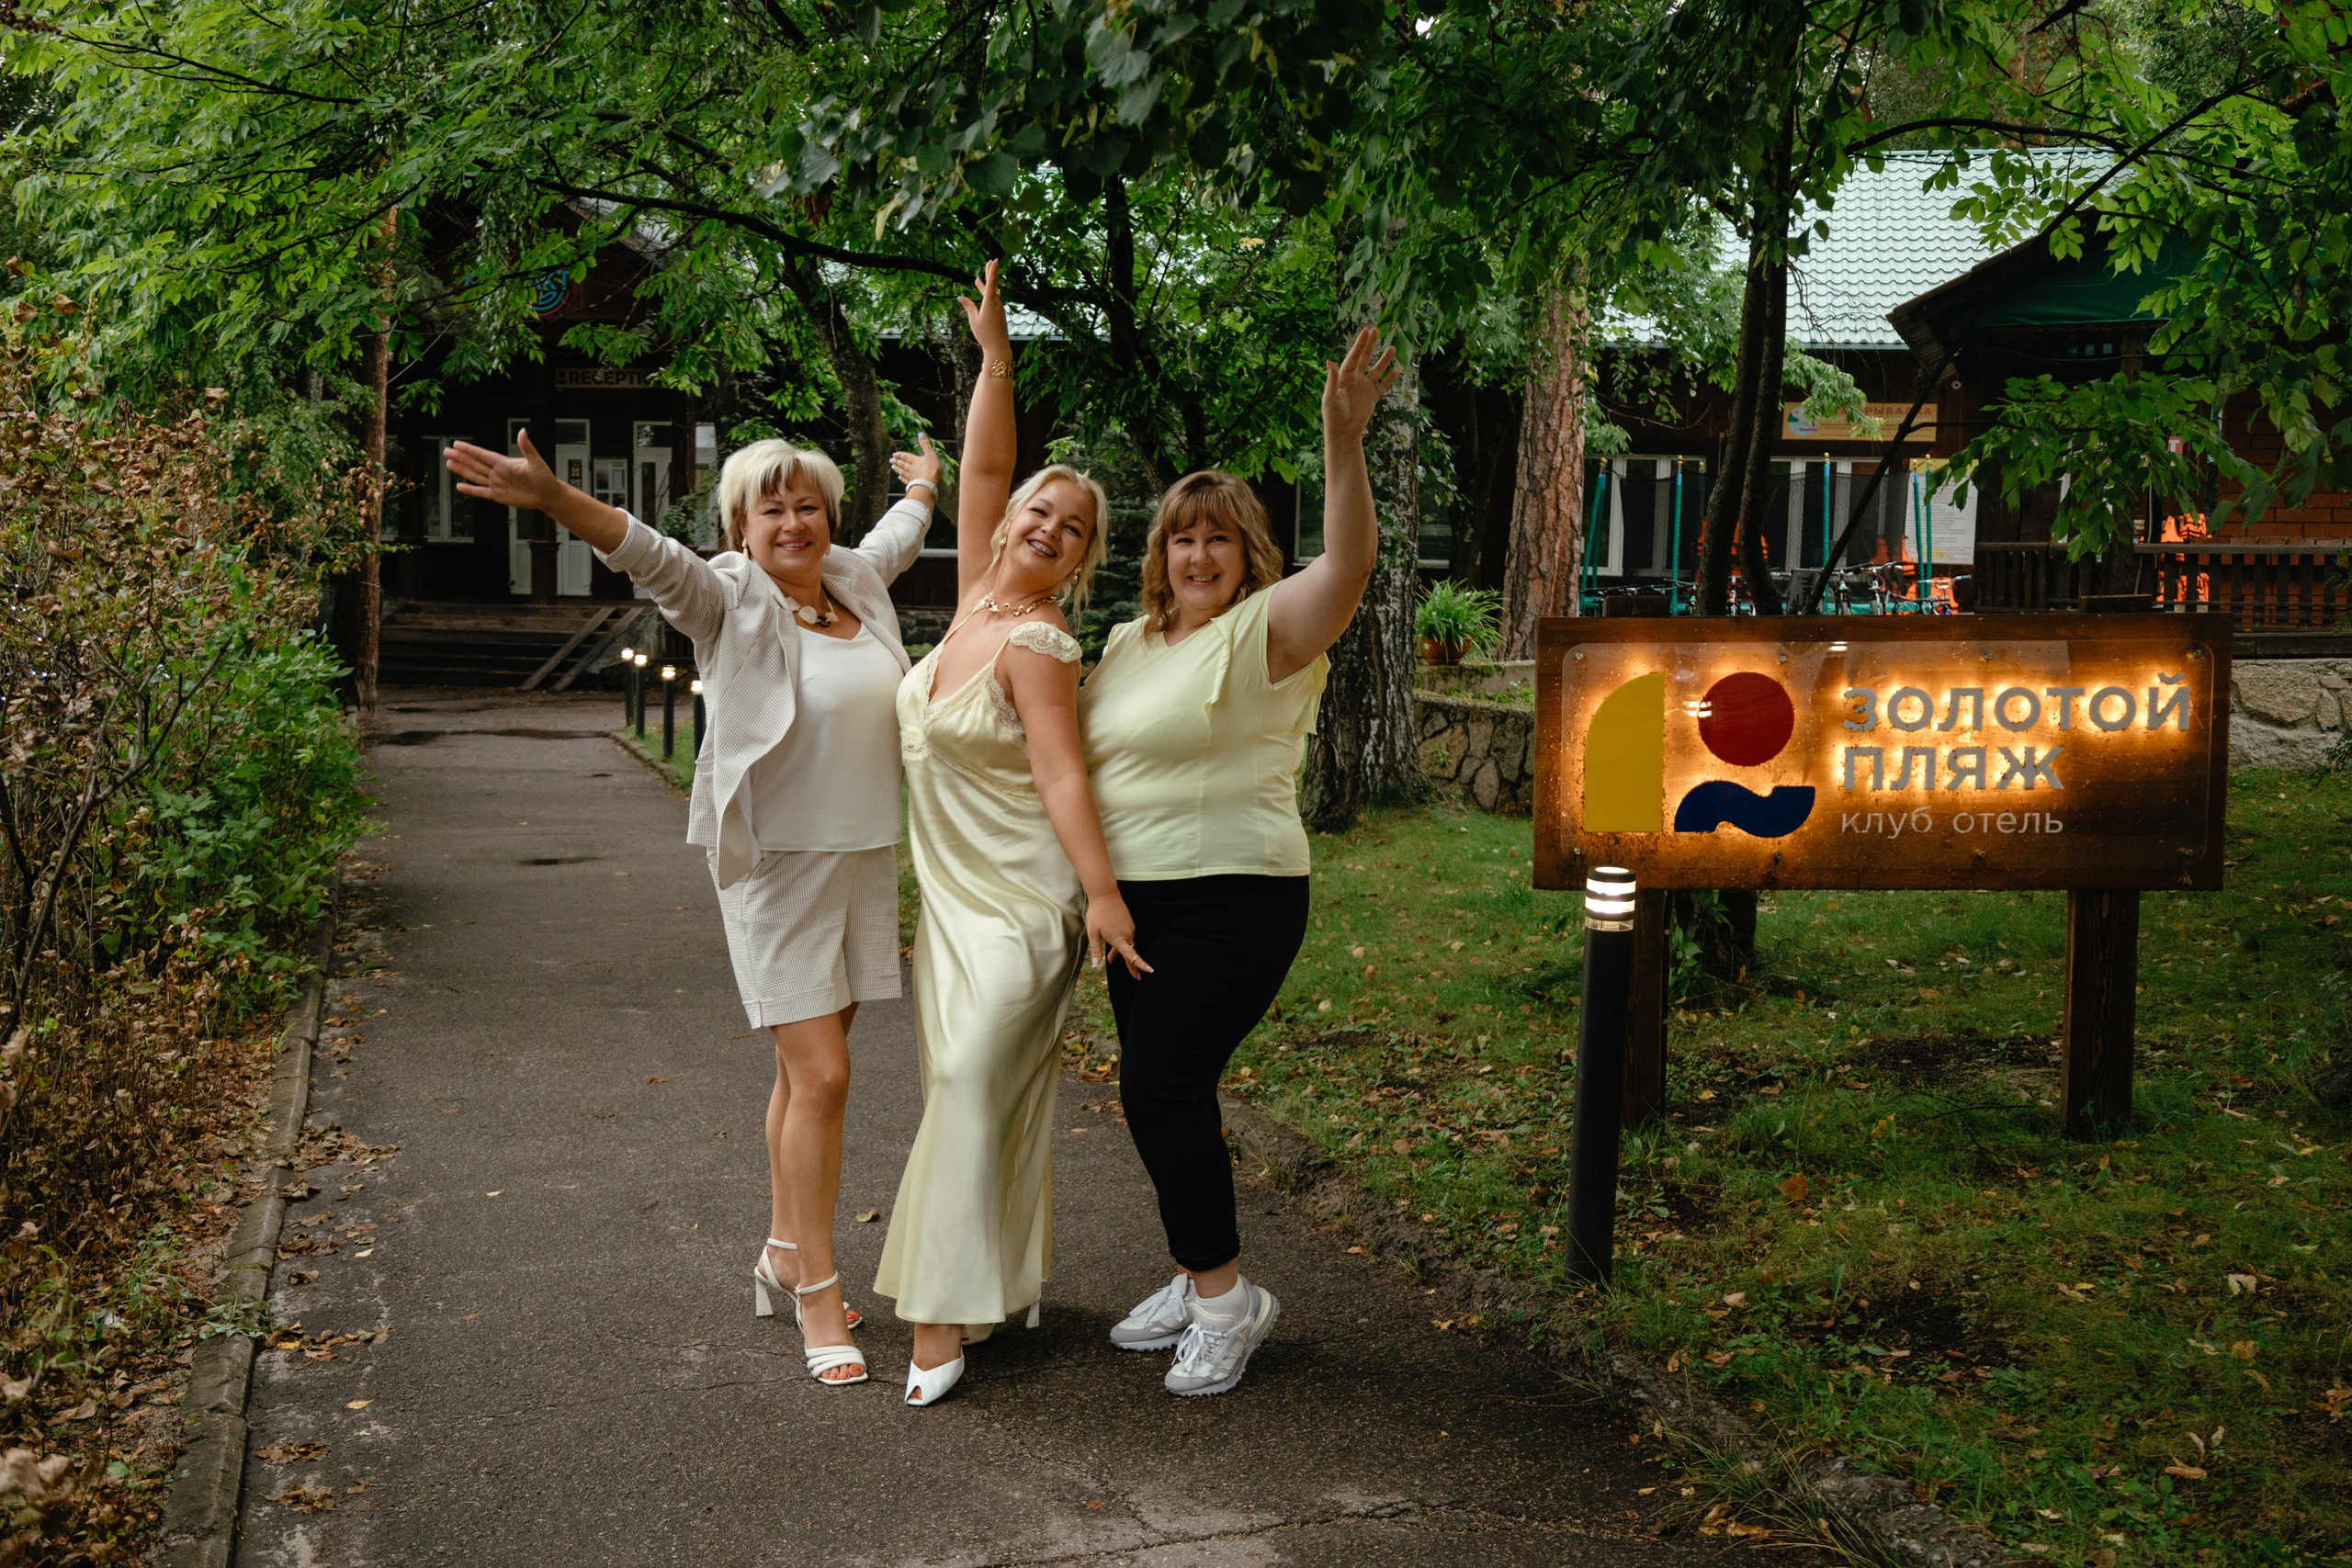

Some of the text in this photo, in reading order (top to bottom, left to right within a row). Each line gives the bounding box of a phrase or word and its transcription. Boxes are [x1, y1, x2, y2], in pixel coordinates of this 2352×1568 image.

[1842, 671, 2190, 732] ЗОЛОТОЙ
[1844, 746, 2064, 790] ПЛЯЖ
[1842, 806, 2064, 840] клуб отель
